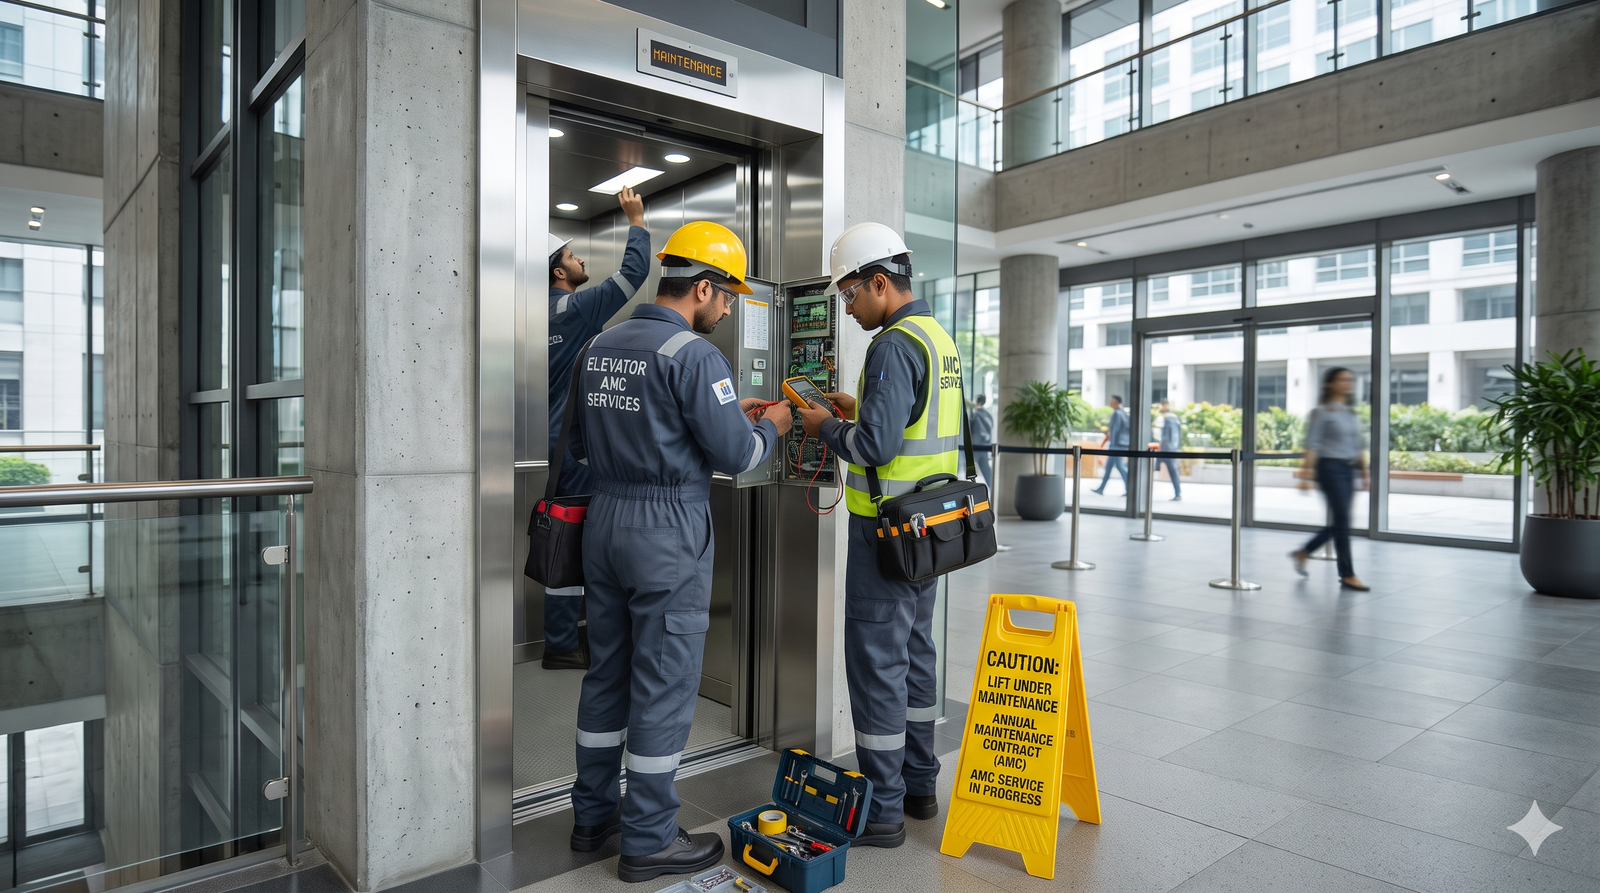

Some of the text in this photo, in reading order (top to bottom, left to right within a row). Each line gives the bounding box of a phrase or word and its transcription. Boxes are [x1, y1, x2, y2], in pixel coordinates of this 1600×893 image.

[653, 48, 722, 78] MAINTENANCE
[587, 356, 647, 376] ELEVATOR
[600, 376, 627, 392] AMC
[587, 393, 640, 412] SERVICES
[987, 650, 1060, 675] CAUTION:
[987, 675, 1052, 695] LIFT UNDER
[978, 690, 1058, 713] MAINTENANCE
[992, 713, 1038, 730] ANNUAL
[974, 723, 1054, 746] MAINTENANCE
[982, 738, 1042, 758] CONTRACT
[993, 755, 1027, 772] (AMC)
[970, 769, 1044, 793] AMC SERVICE
[969, 782, 1042, 806] IN PROGRESS
